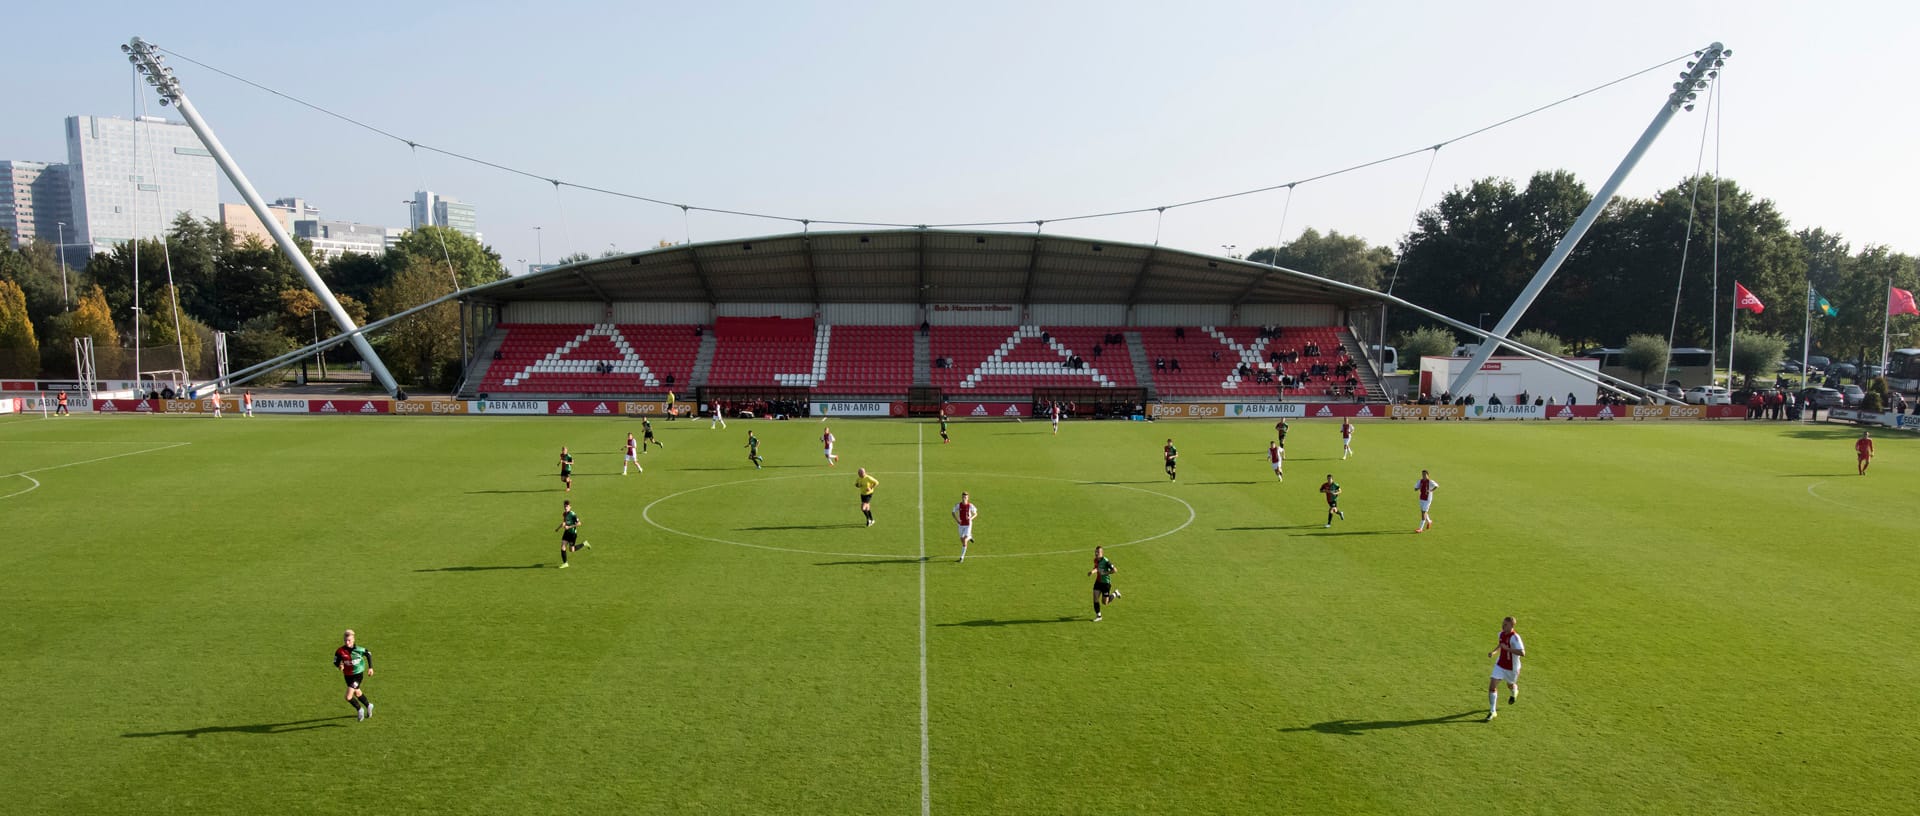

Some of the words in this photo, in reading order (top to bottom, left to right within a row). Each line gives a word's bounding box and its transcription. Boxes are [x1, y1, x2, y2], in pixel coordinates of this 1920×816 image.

[166, 400, 196, 411] Ziggo
[203, 400, 232, 411] Zgo
[395, 402, 424, 413] Ziggo
[431, 402, 461, 413] Ziggo
[625, 402, 654, 413] Ziggo
[1152, 404, 1182, 416] Ziggo
[1188, 404, 1218, 416] Ziggo
[1392, 405, 1422, 417] Ziggo
[1428, 405, 1458, 417] Ziggo
[1633, 405, 1663, 416] Ziggo
[1669, 405, 1700, 416] Ziggo
